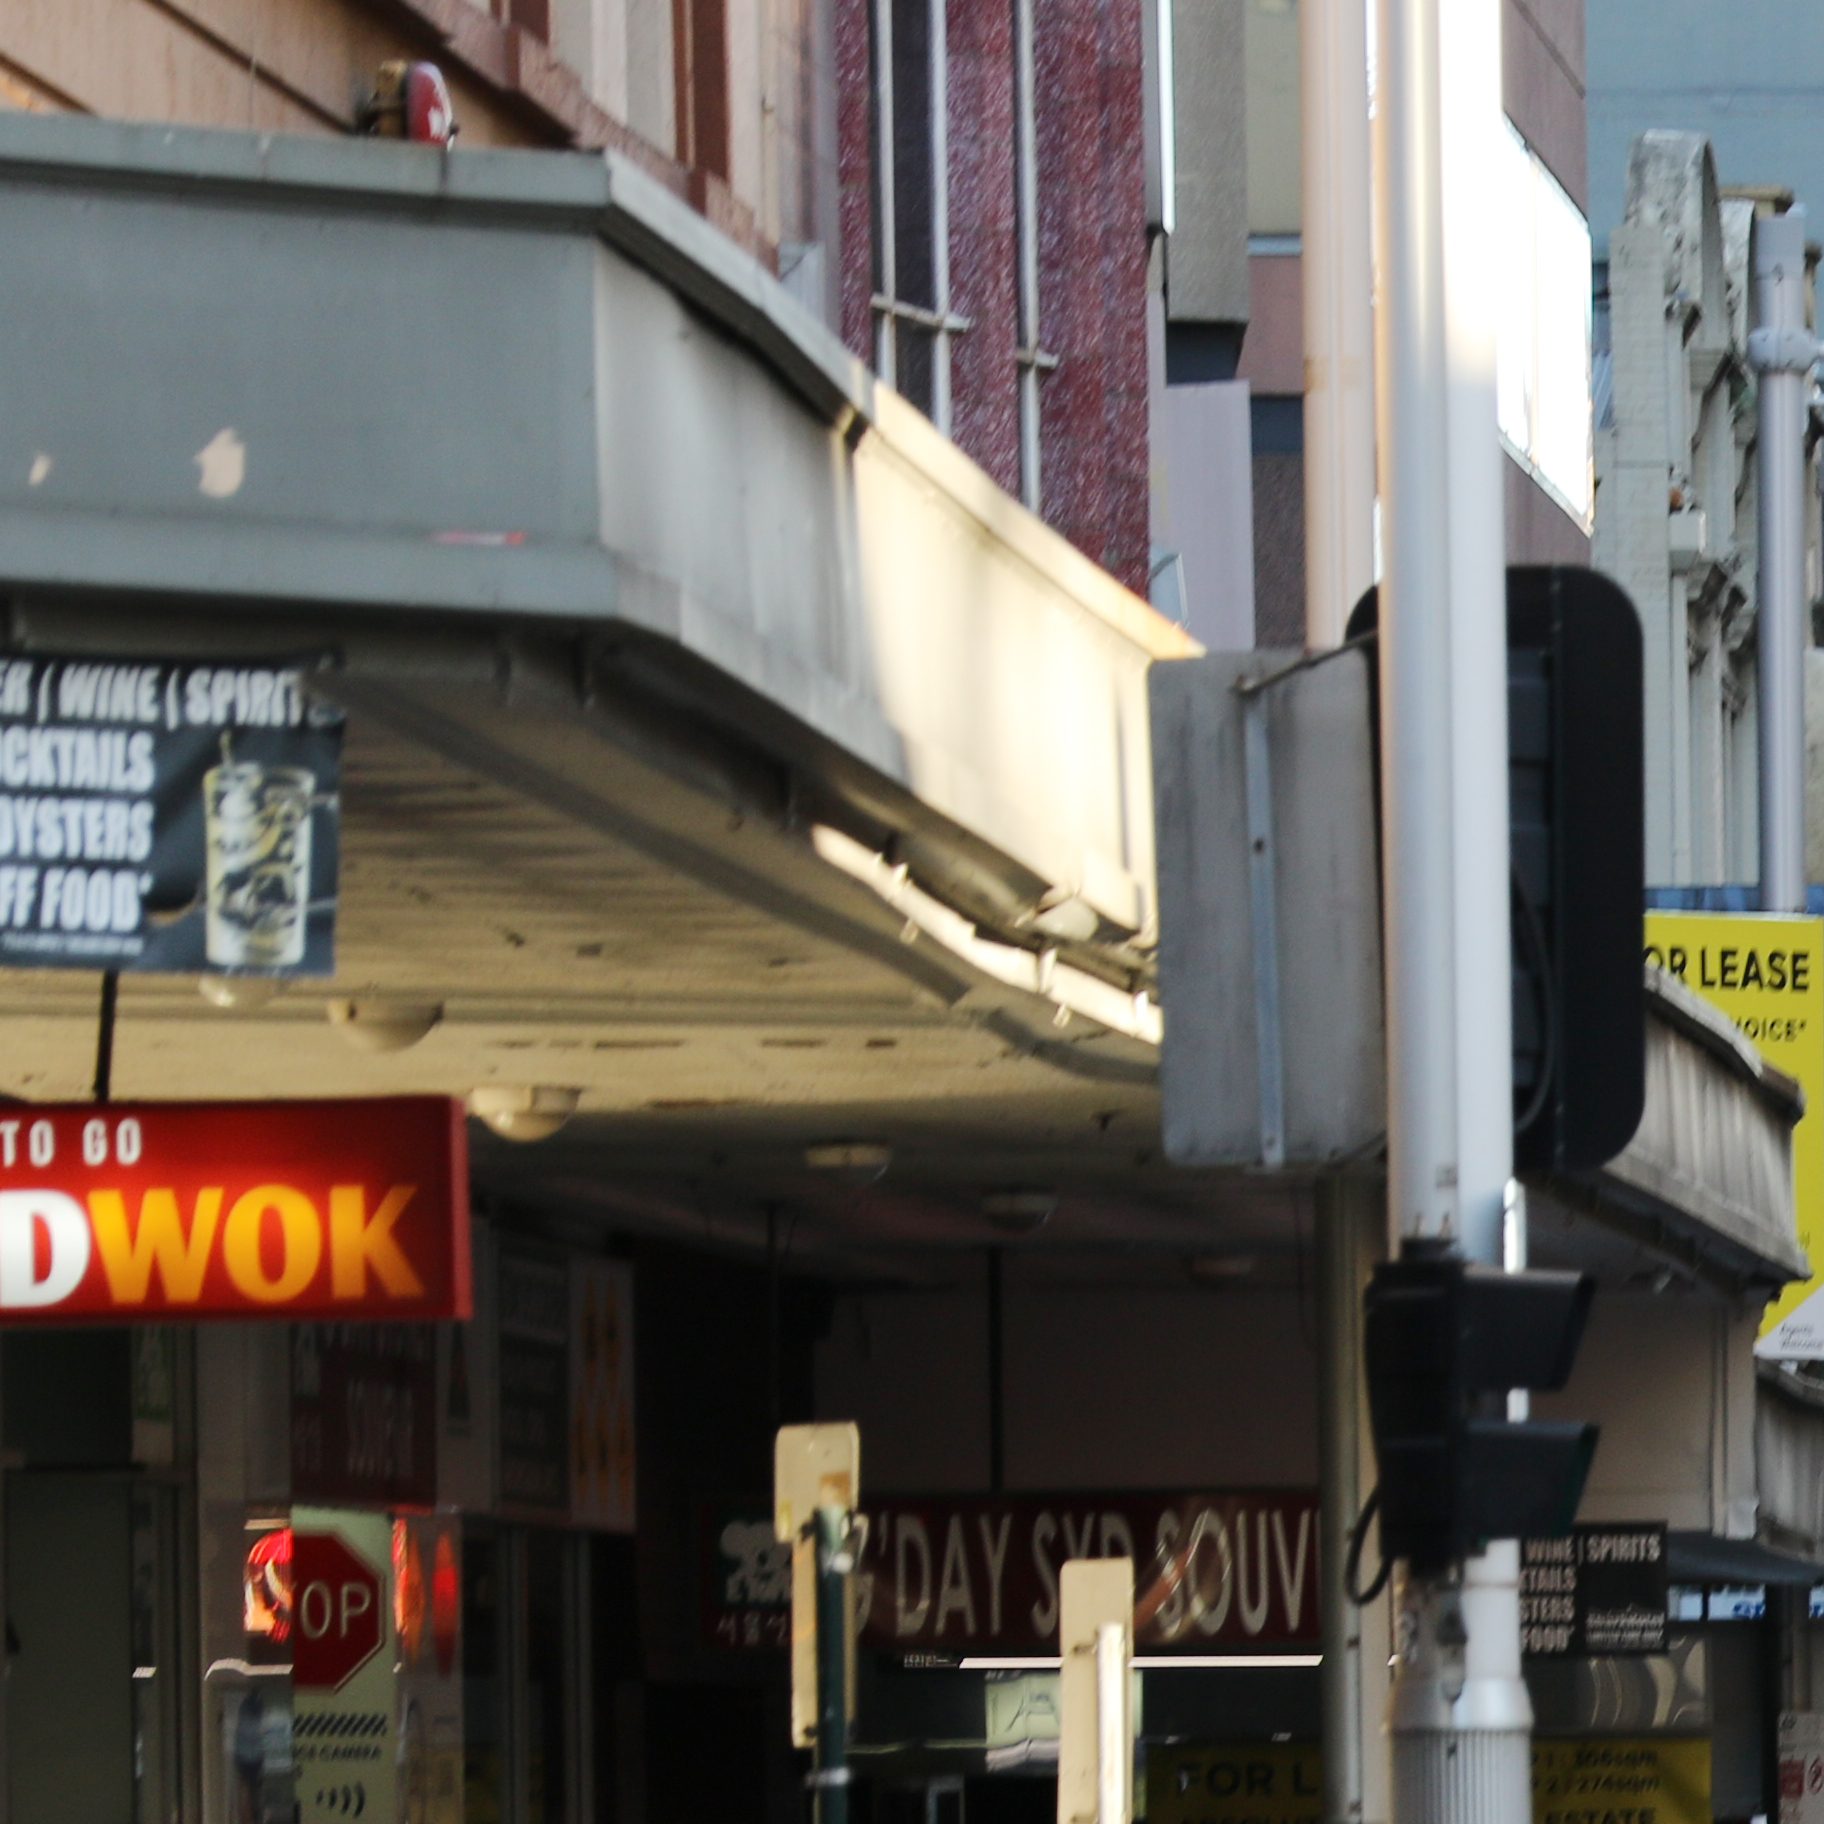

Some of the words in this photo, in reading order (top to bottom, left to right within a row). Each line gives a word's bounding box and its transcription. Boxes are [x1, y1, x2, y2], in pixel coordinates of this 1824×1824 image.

[59, 663, 161, 723] WINE
[185, 667, 303, 728] SPIRIT
[0, 724, 155, 793] CKTAILS
[1700, 945, 1811, 992] LEASE
[1, 1121, 55, 1167] TO
[82, 1118, 142, 1166] GO
[1155, 1507, 1322, 1640] SOUV
[1586, 1532, 1663, 1564] SPIRITS
[301, 1578, 373, 1640] OP
[1175, 1760, 1277, 1798] FOR
